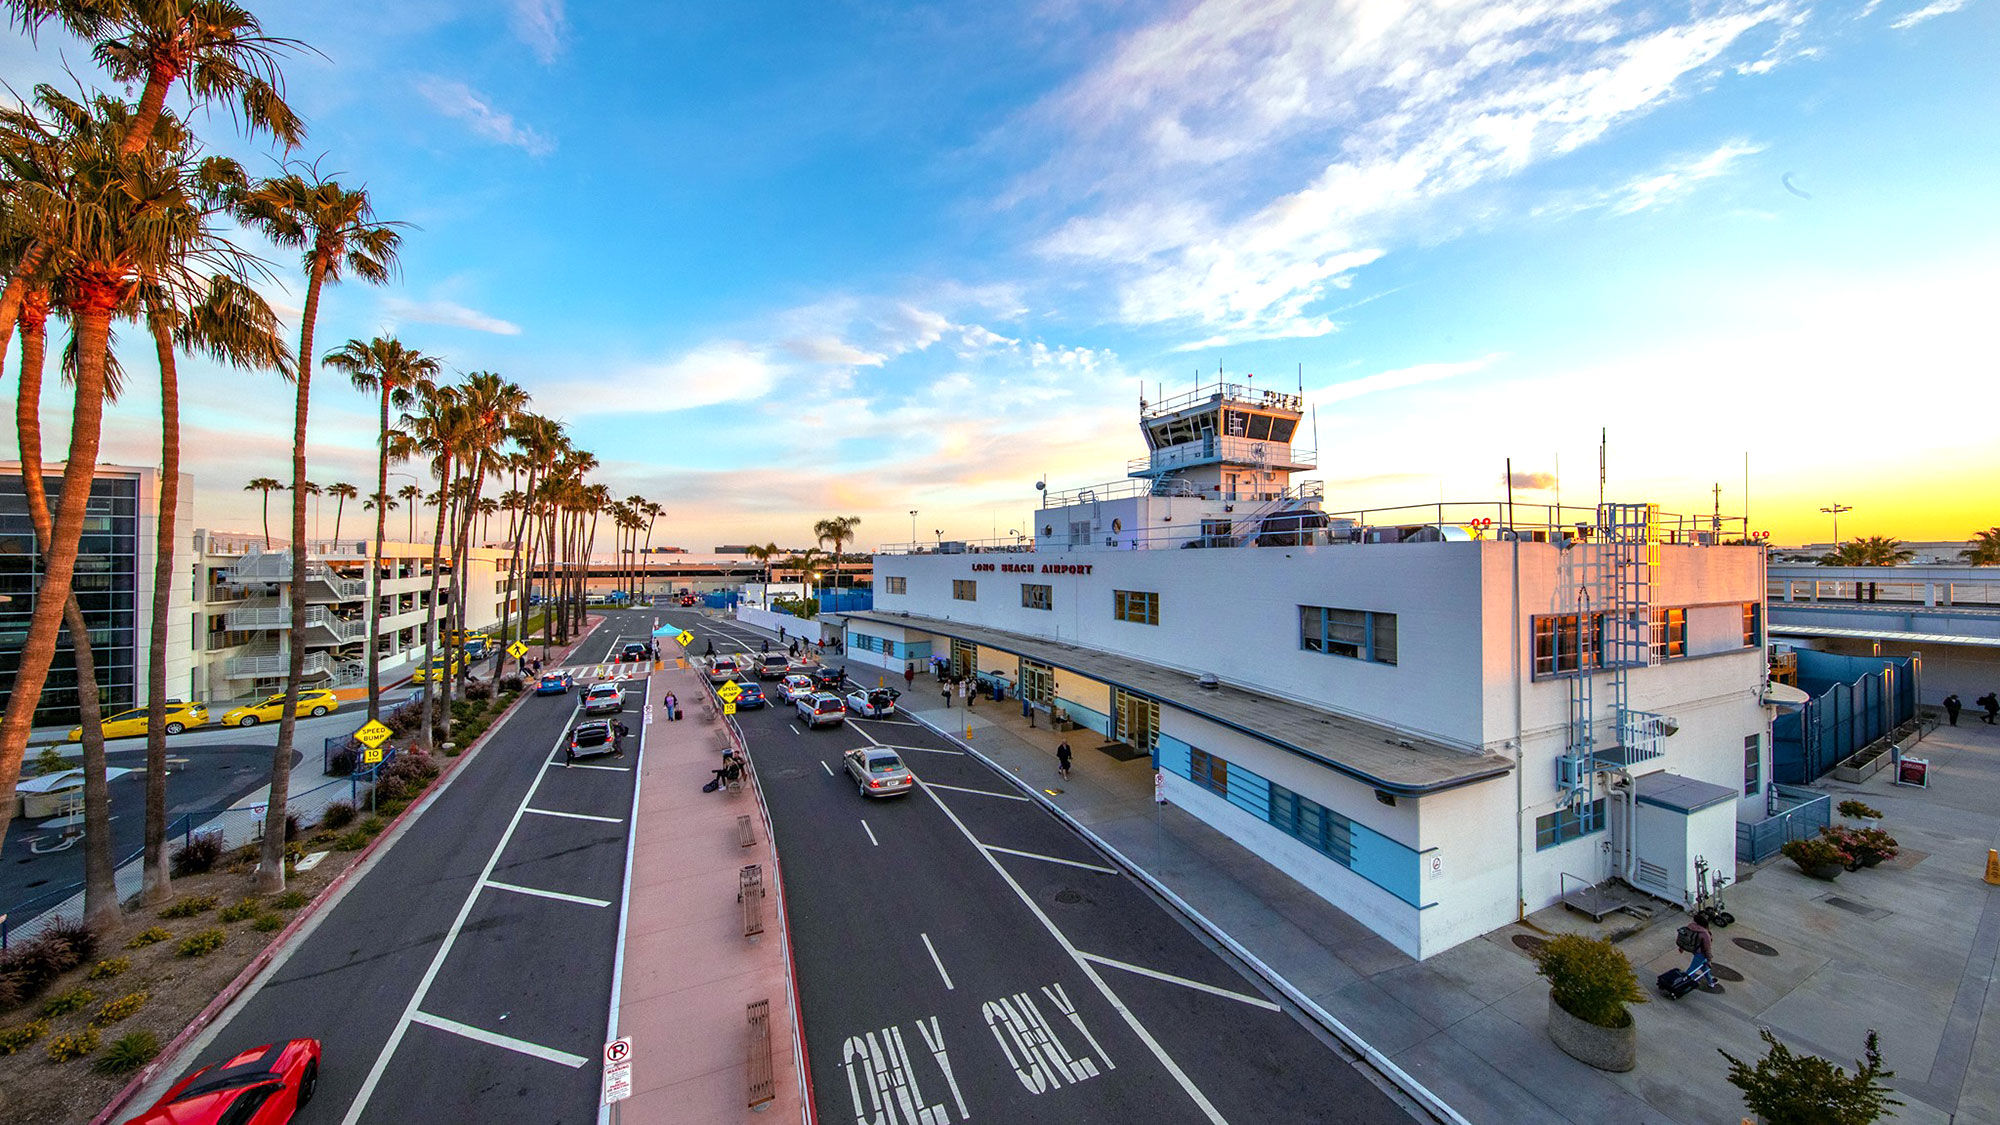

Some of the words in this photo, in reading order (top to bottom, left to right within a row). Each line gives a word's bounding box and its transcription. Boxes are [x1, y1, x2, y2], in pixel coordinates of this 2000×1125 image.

[971, 563, 996, 572] LONG
[1001, 564, 1034, 573] BEACH
[1041, 564, 1093, 575] AIRPORT
[362, 727, 386, 735] SPEED
[363, 734, 385, 742] BUMP
[368, 750, 379, 758] 10
[982, 983, 1116, 1094] ONLY
[607, 1064, 630, 1074] WARNING
[843, 1016, 970, 1125] ONLY
